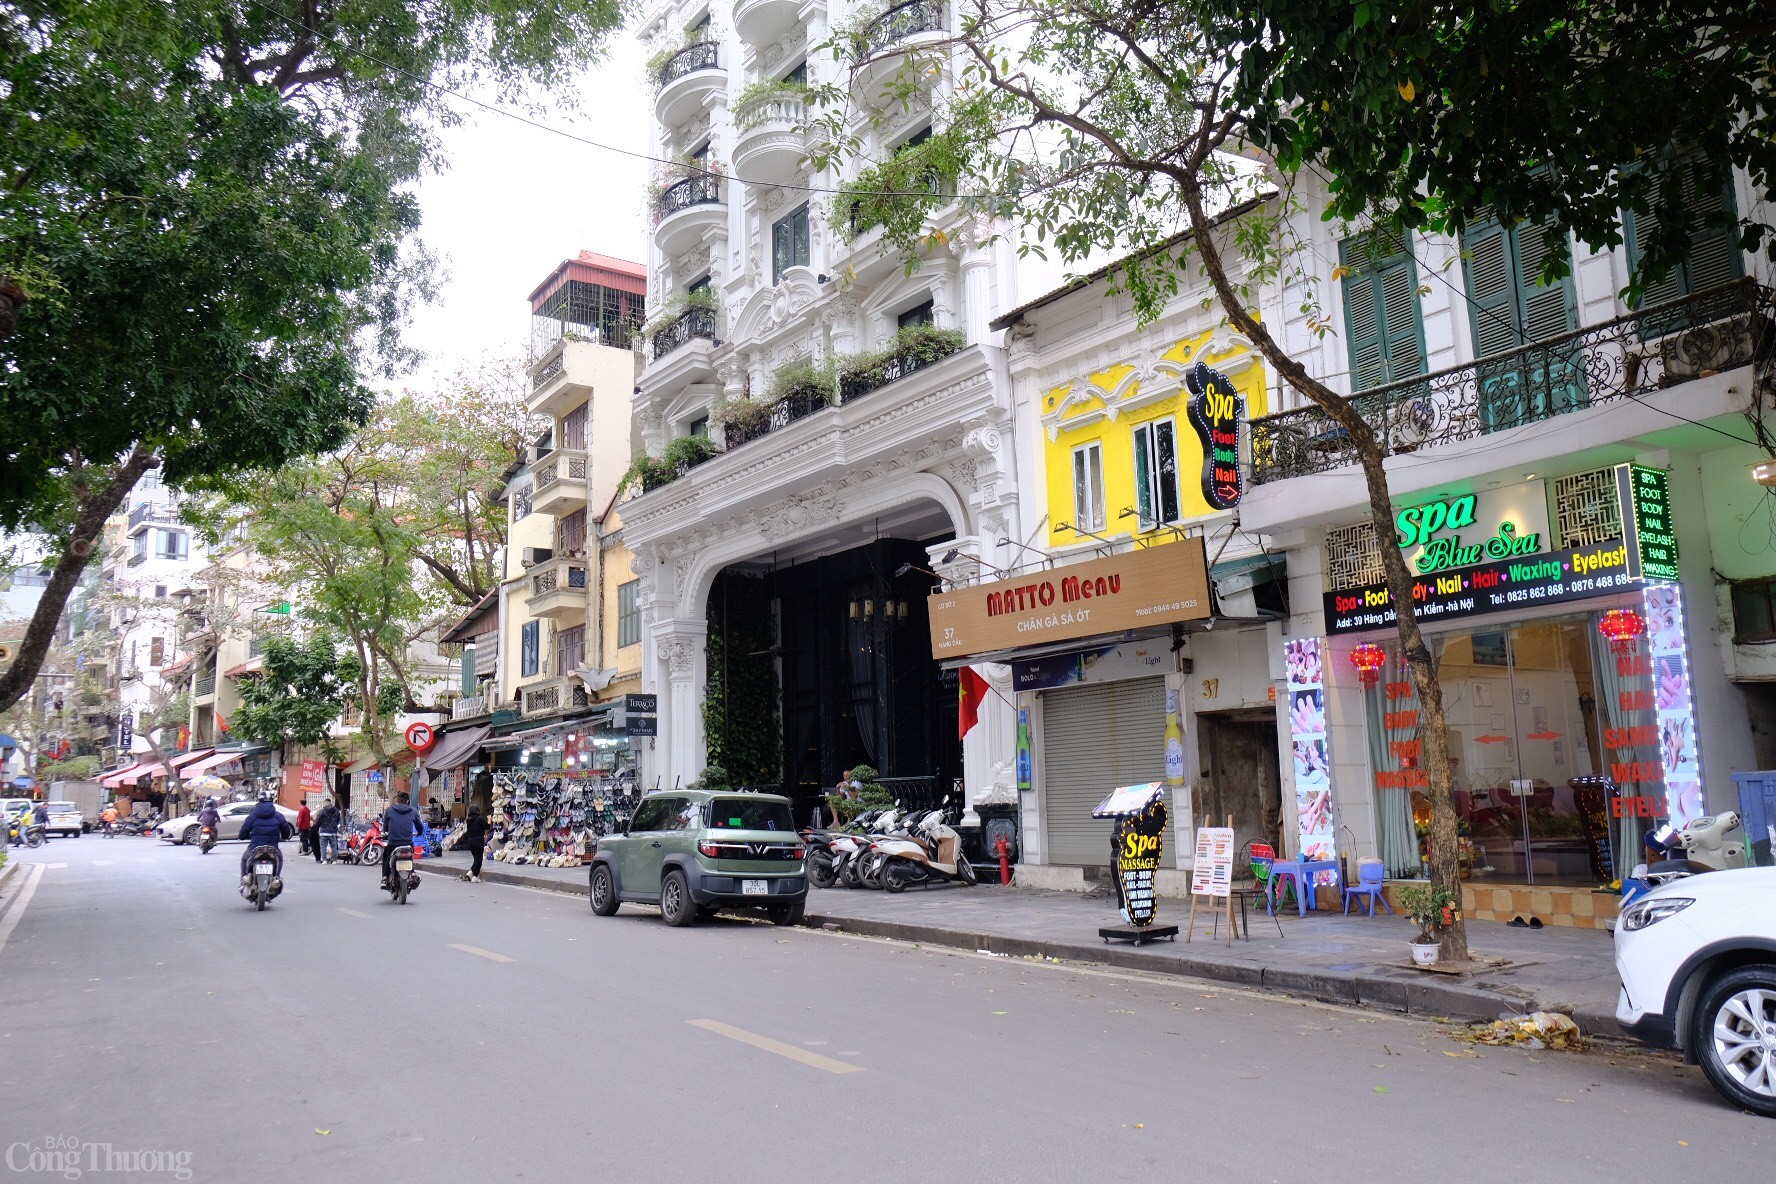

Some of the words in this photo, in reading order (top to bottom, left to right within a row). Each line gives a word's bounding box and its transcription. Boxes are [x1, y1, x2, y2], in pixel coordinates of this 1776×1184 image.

[1205, 383, 1234, 427] Spa
[1212, 429, 1235, 445] Foot
[1214, 447, 1235, 465] Body
[1215, 468, 1237, 483] Nail
[1641, 472, 1656, 485] SPA
[1640, 487, 1661, 500] FOOT
[1641, 501, 1662, 515] BODY
[1396, 494, 1477, 549] Spa
[1645, 517, 1663, 530] NAIL
[1415, 535, 1483, 573] Blue
[1485, 521, 1541, 559] Sea
[1640, 531, 1672, 546] EYELASH
[1648, 547, 1667, 560] HAIR
[1644, 562, 1676, 576] WAXING
[986, 581, 1055, 617] MATTO
[1061, 573, 1121, 603] Menu
[1336, 595, 1357, 614] Spa
[1365, 588, 1389, 607] Foot
[1412, 581, 1427, 601] dy
[1437, 574, 1462, 596] Nail
[1472, 568, 1499, 590] Hair
[1509, 560, 1561, 581] Waxing
[1490, 594, 1505, 605] Tel:
[1507, 589, 1528, 602] 0825
[1529, 587, 1545, 599] 862
[1547, 583, 1564, 597] 868
[1571, 578, 1594, 592] 0876
[1596, 576, 1613, 589] 468
[1153, 604, 1170, 613] 0944
[1180, 599, 1198, 609] 5025
[1336, 618, 1353, 628] Add:
[1354, 616, 1363, 626] 39
[1364, 613, 1383, 625] Hàng
[1460, 597, 1474, 611] Nội
[1017, 616, 1043, 633] CHÂN
[1045, 613, 1059, 628] GÀ
[1076, 608, 1090, 622] ỚT
[944, 627, 955, 640] 37
[1020, 674, 1034, 682] BOLD
[1202, 678, 1219, 699] 37
[1385, 681, 1413, 700] SPA
[1384, 709, 1418, 730] BODY
[1390, 739, 1423, 758] FOOT
[1375, 768, 1429, 789] MASSA
[1125, 832, 1158, 858] Spa
[1121, 857, 1155, 870] MASSAGE
[1124, 871, 1136, 880] FOOT
[1139, 870, 1152, 880] BODY
